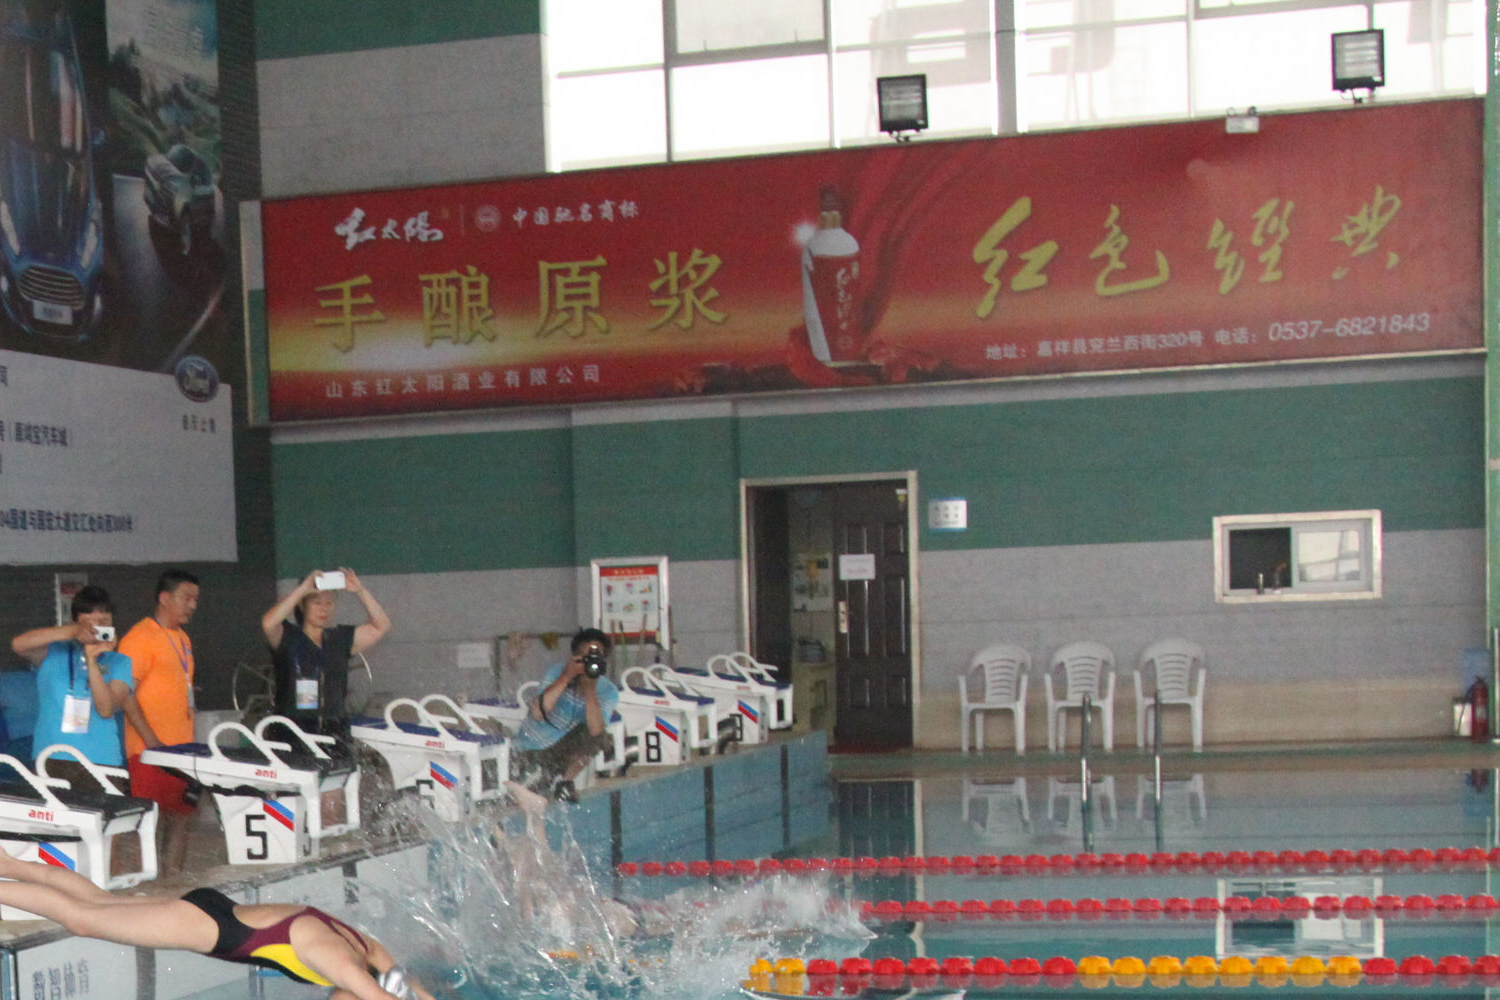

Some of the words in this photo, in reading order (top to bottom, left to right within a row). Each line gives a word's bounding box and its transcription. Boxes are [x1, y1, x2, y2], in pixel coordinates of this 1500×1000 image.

[314, 248, 730, 354] 手酿原浆
[1268, 313, 1431, 343] 0537-6821843
[325, 363, 601, 399] 山东红太阳酒业有限公司
[645, 731, 661, 762] 8
[255, 767, 277, 779] anti
[28, 808, 54, 822] anti
[245, 814, 268, 860] 5
